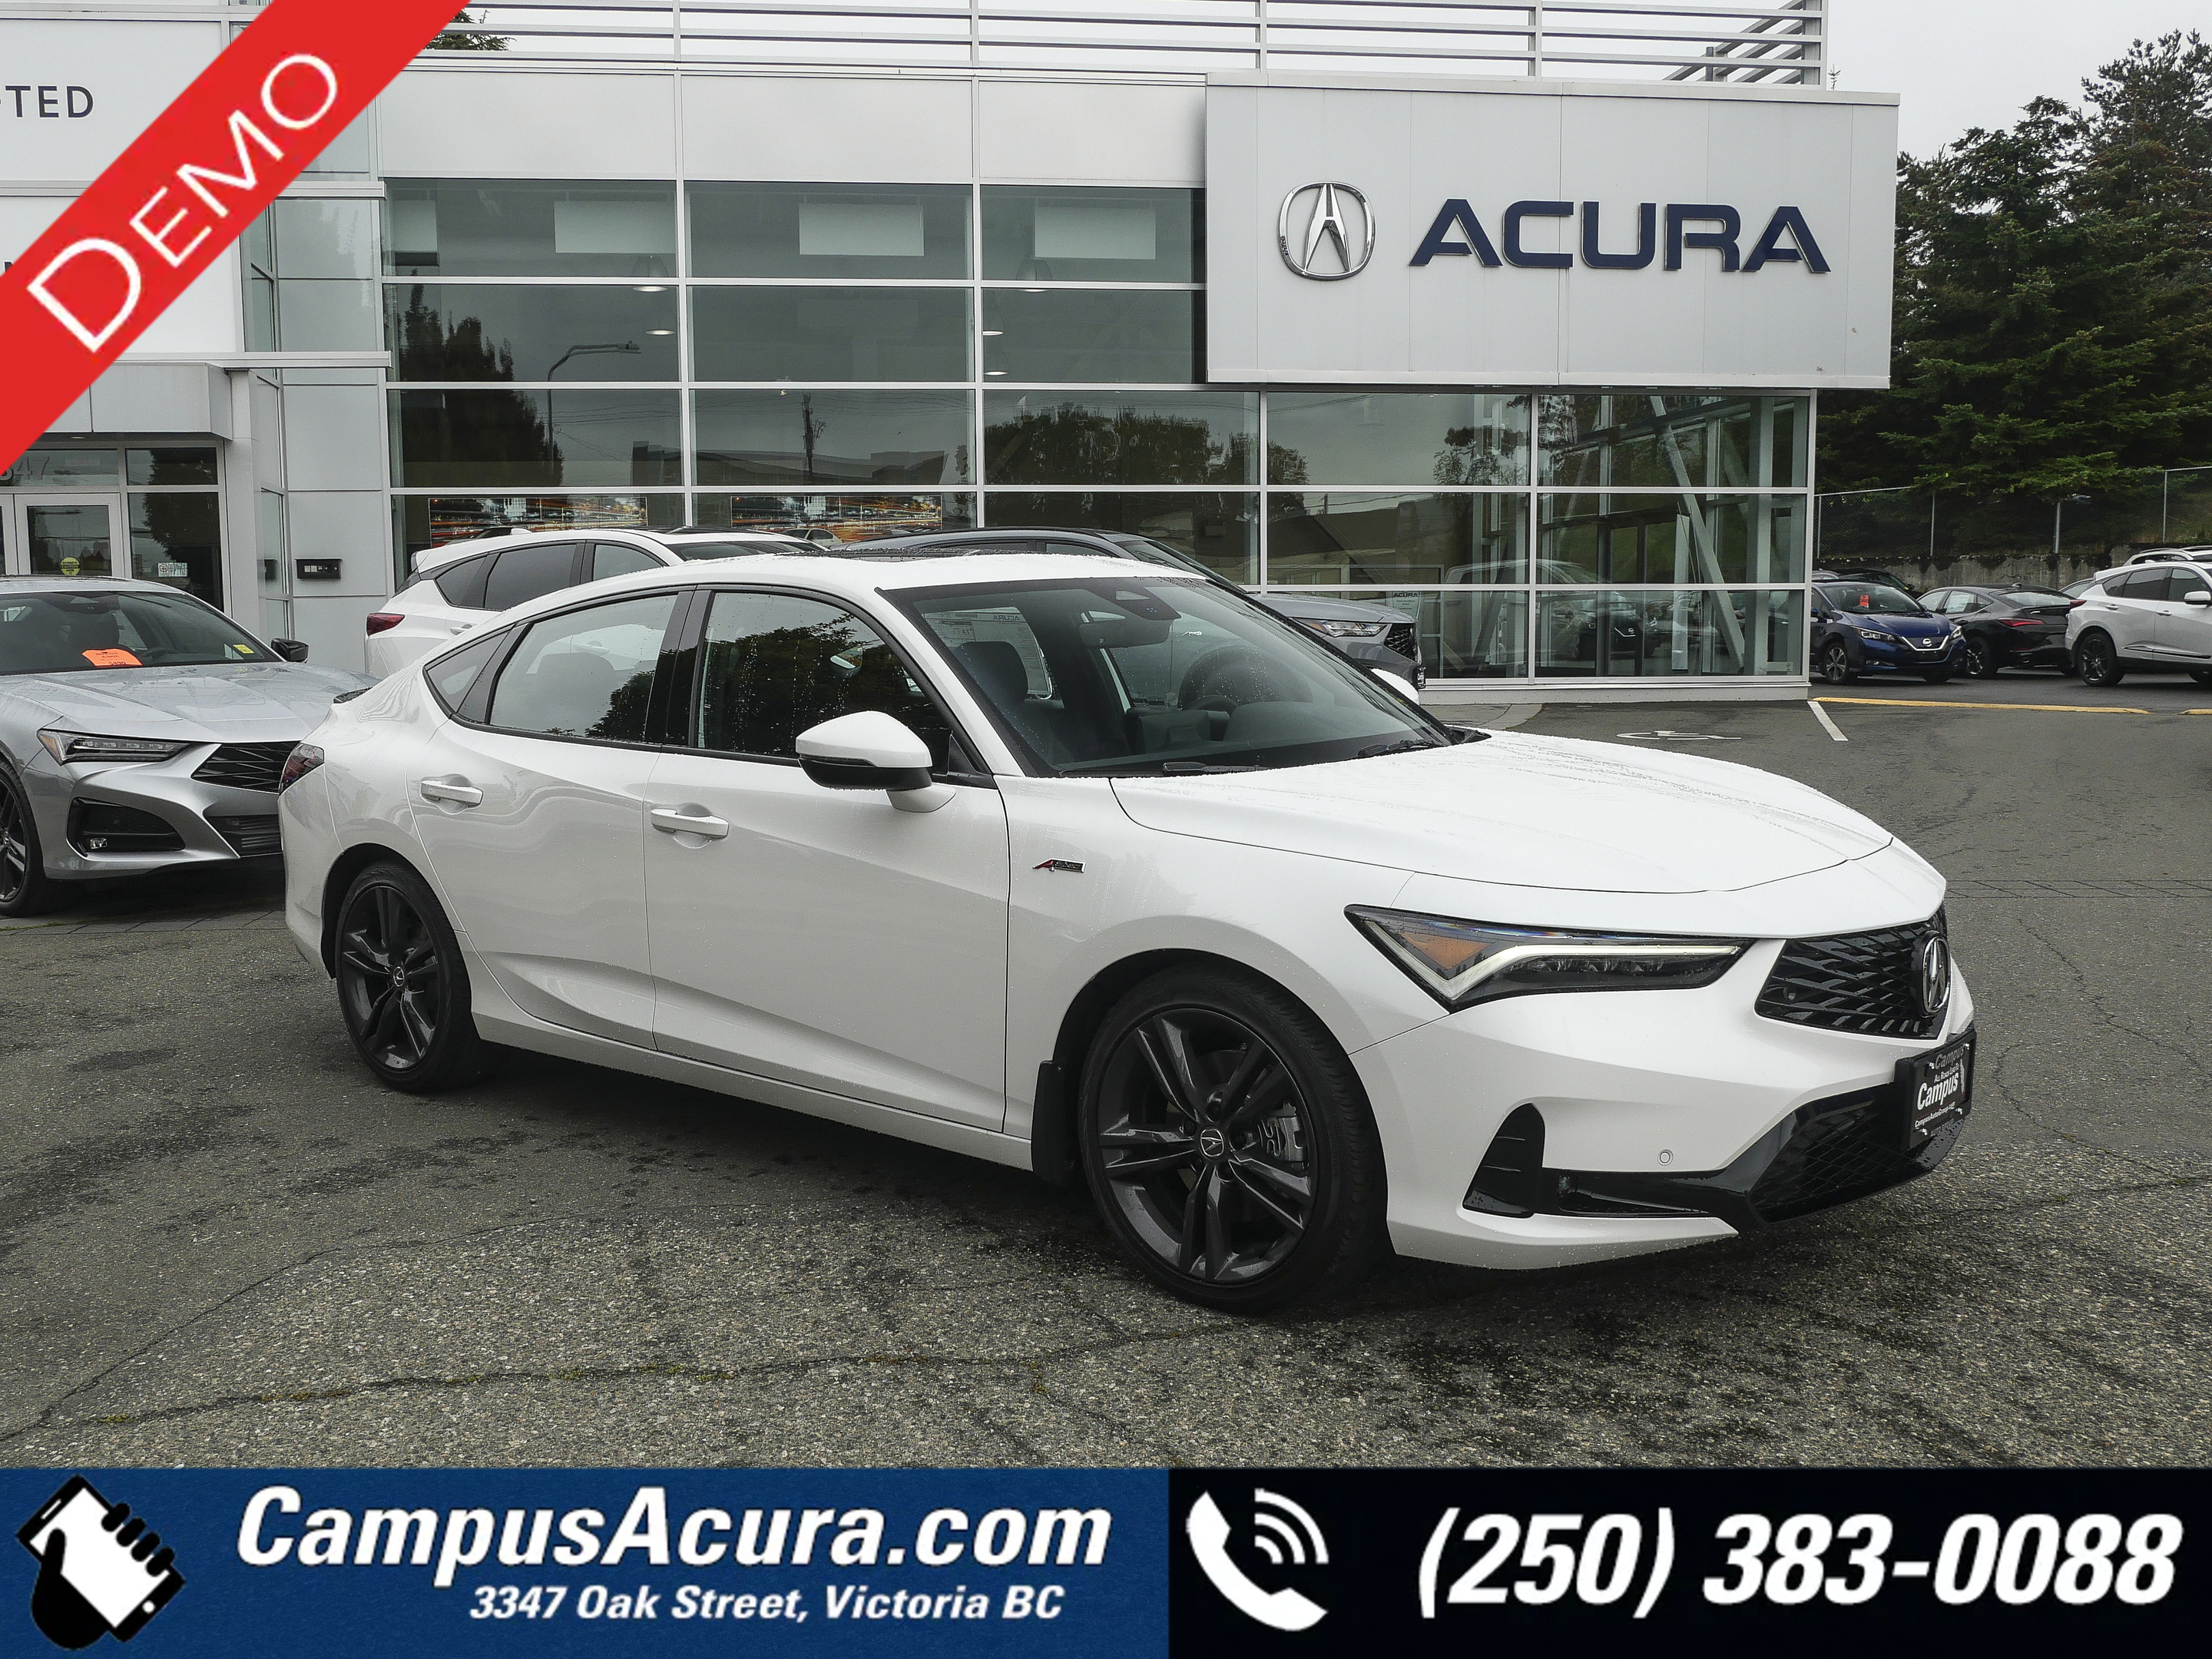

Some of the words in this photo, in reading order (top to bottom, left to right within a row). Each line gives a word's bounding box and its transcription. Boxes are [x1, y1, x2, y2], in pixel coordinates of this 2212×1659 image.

[0, 86, 93, 118] TED
[1409, 199, 1831, 273] ACURA
[1935, 1046, 1964, 1070] Campus
[1917, 1072, 1959, 1111] Campus
